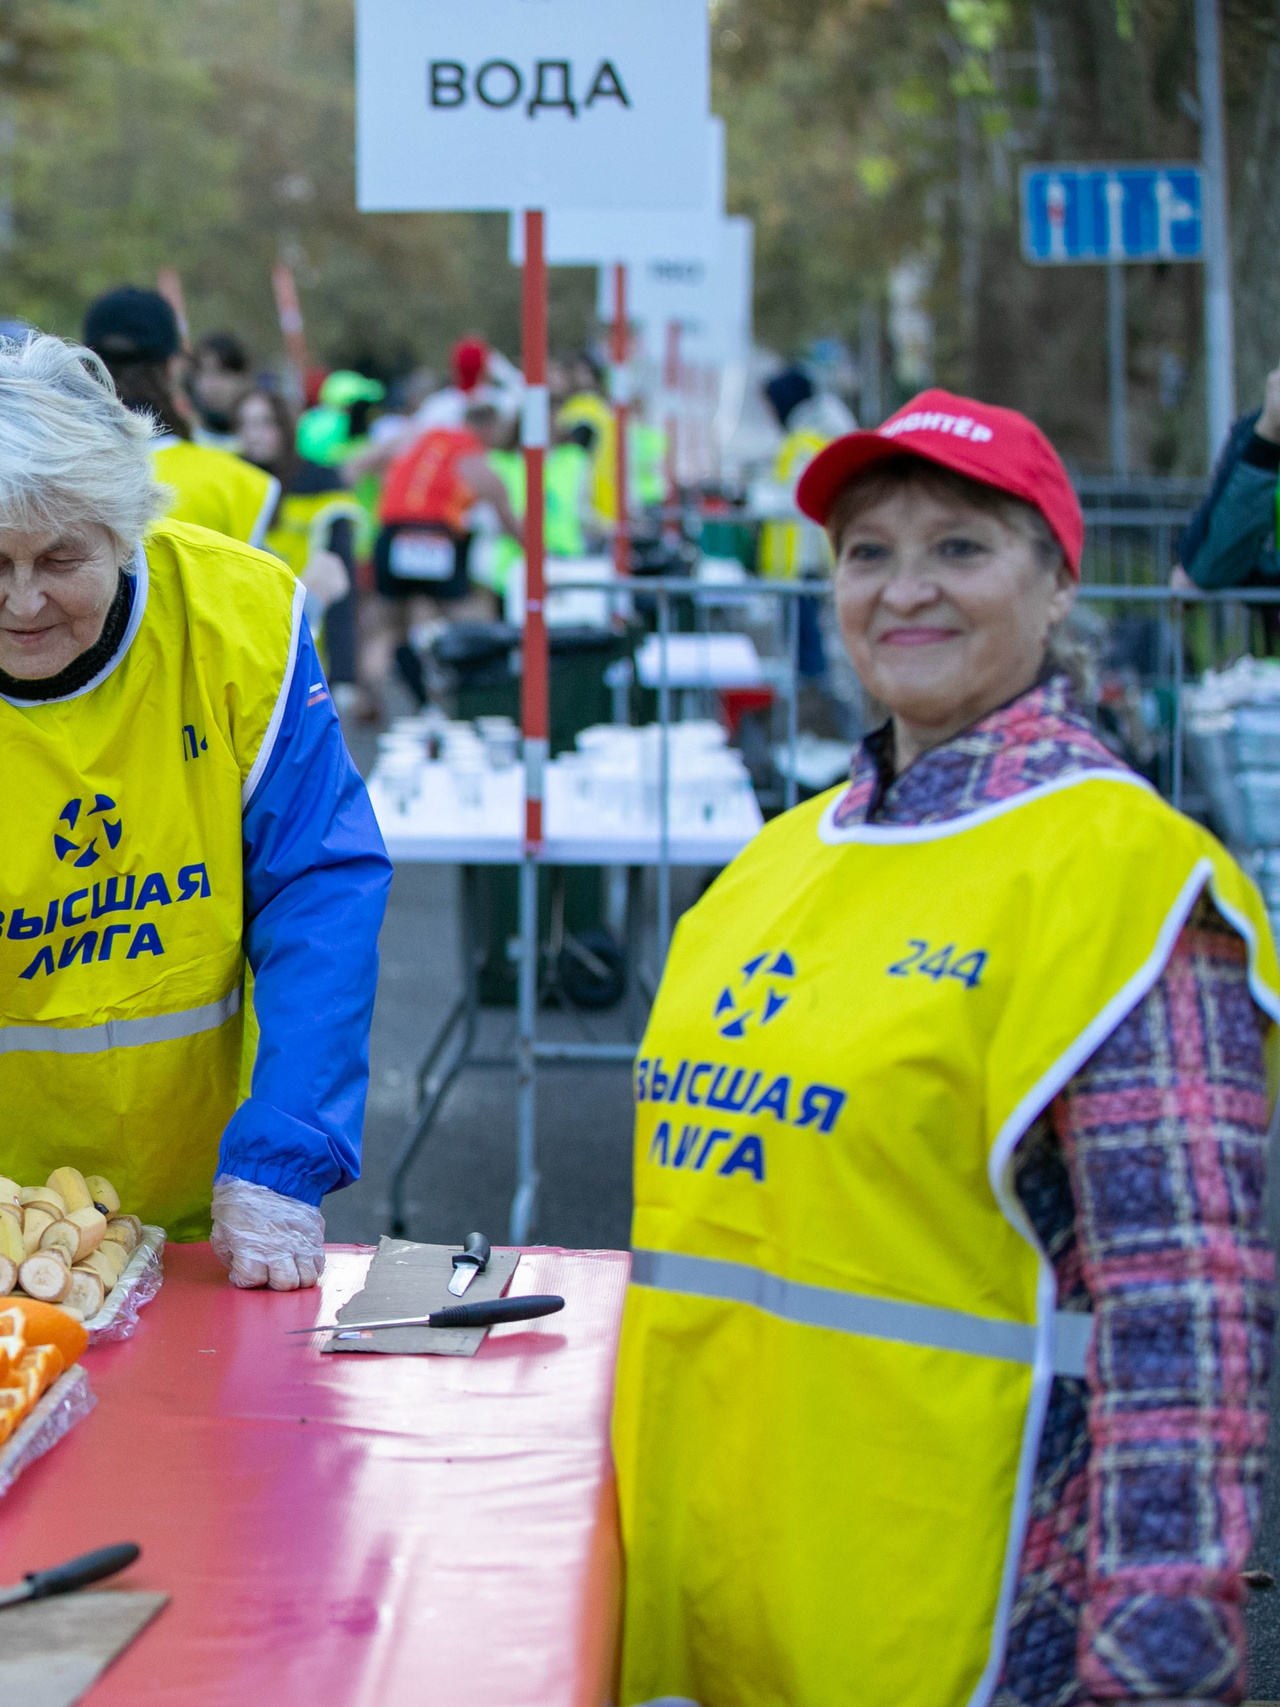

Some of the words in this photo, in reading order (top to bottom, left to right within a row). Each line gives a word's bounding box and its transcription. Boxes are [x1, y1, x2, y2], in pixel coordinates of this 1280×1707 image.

[429, 59, 631, 119] ВОДА
[17, 922, 166, 981] ЛИГА
[885, 938, 990, 989] 244
[648, 1120, 766, 1184] ЛИГА
